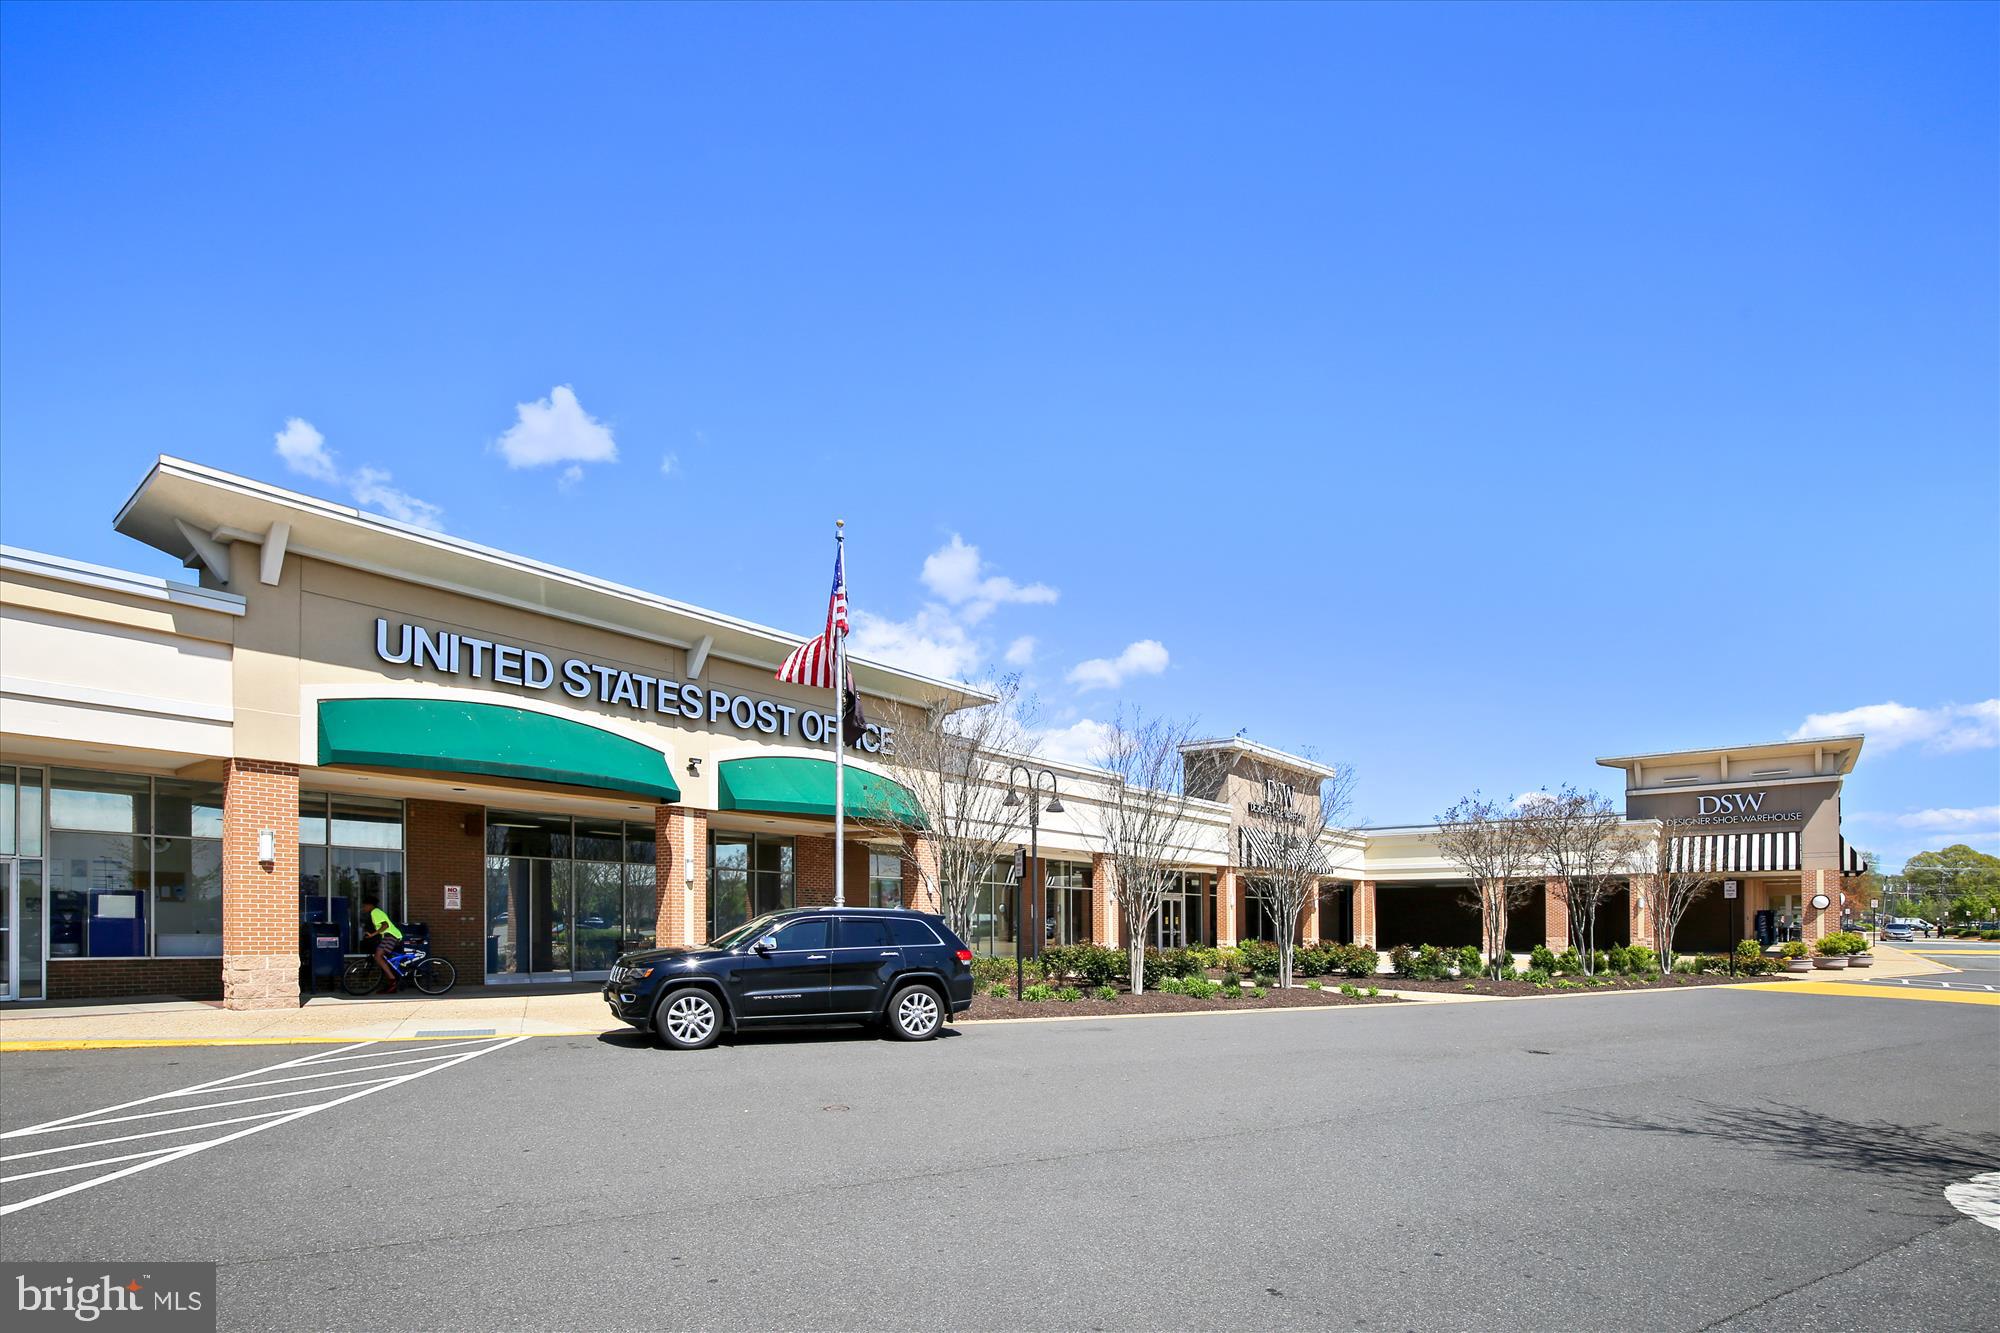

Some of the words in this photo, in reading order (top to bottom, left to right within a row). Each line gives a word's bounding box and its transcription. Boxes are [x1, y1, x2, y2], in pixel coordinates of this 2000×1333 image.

[375, 618, 554, 690] UNITED
[561, 657, 704, 720] STATES
[709, 689, 796, 737] POST
[801, 709, 896, 756] OFCE
[1697, 792, 1767, 816] DSW
[1666, 816, 1711, 827] DESIGNER
[1712, 815, 1739, 825] SHOE
[1740, 812, 1803, 823] WAREHOUSE
